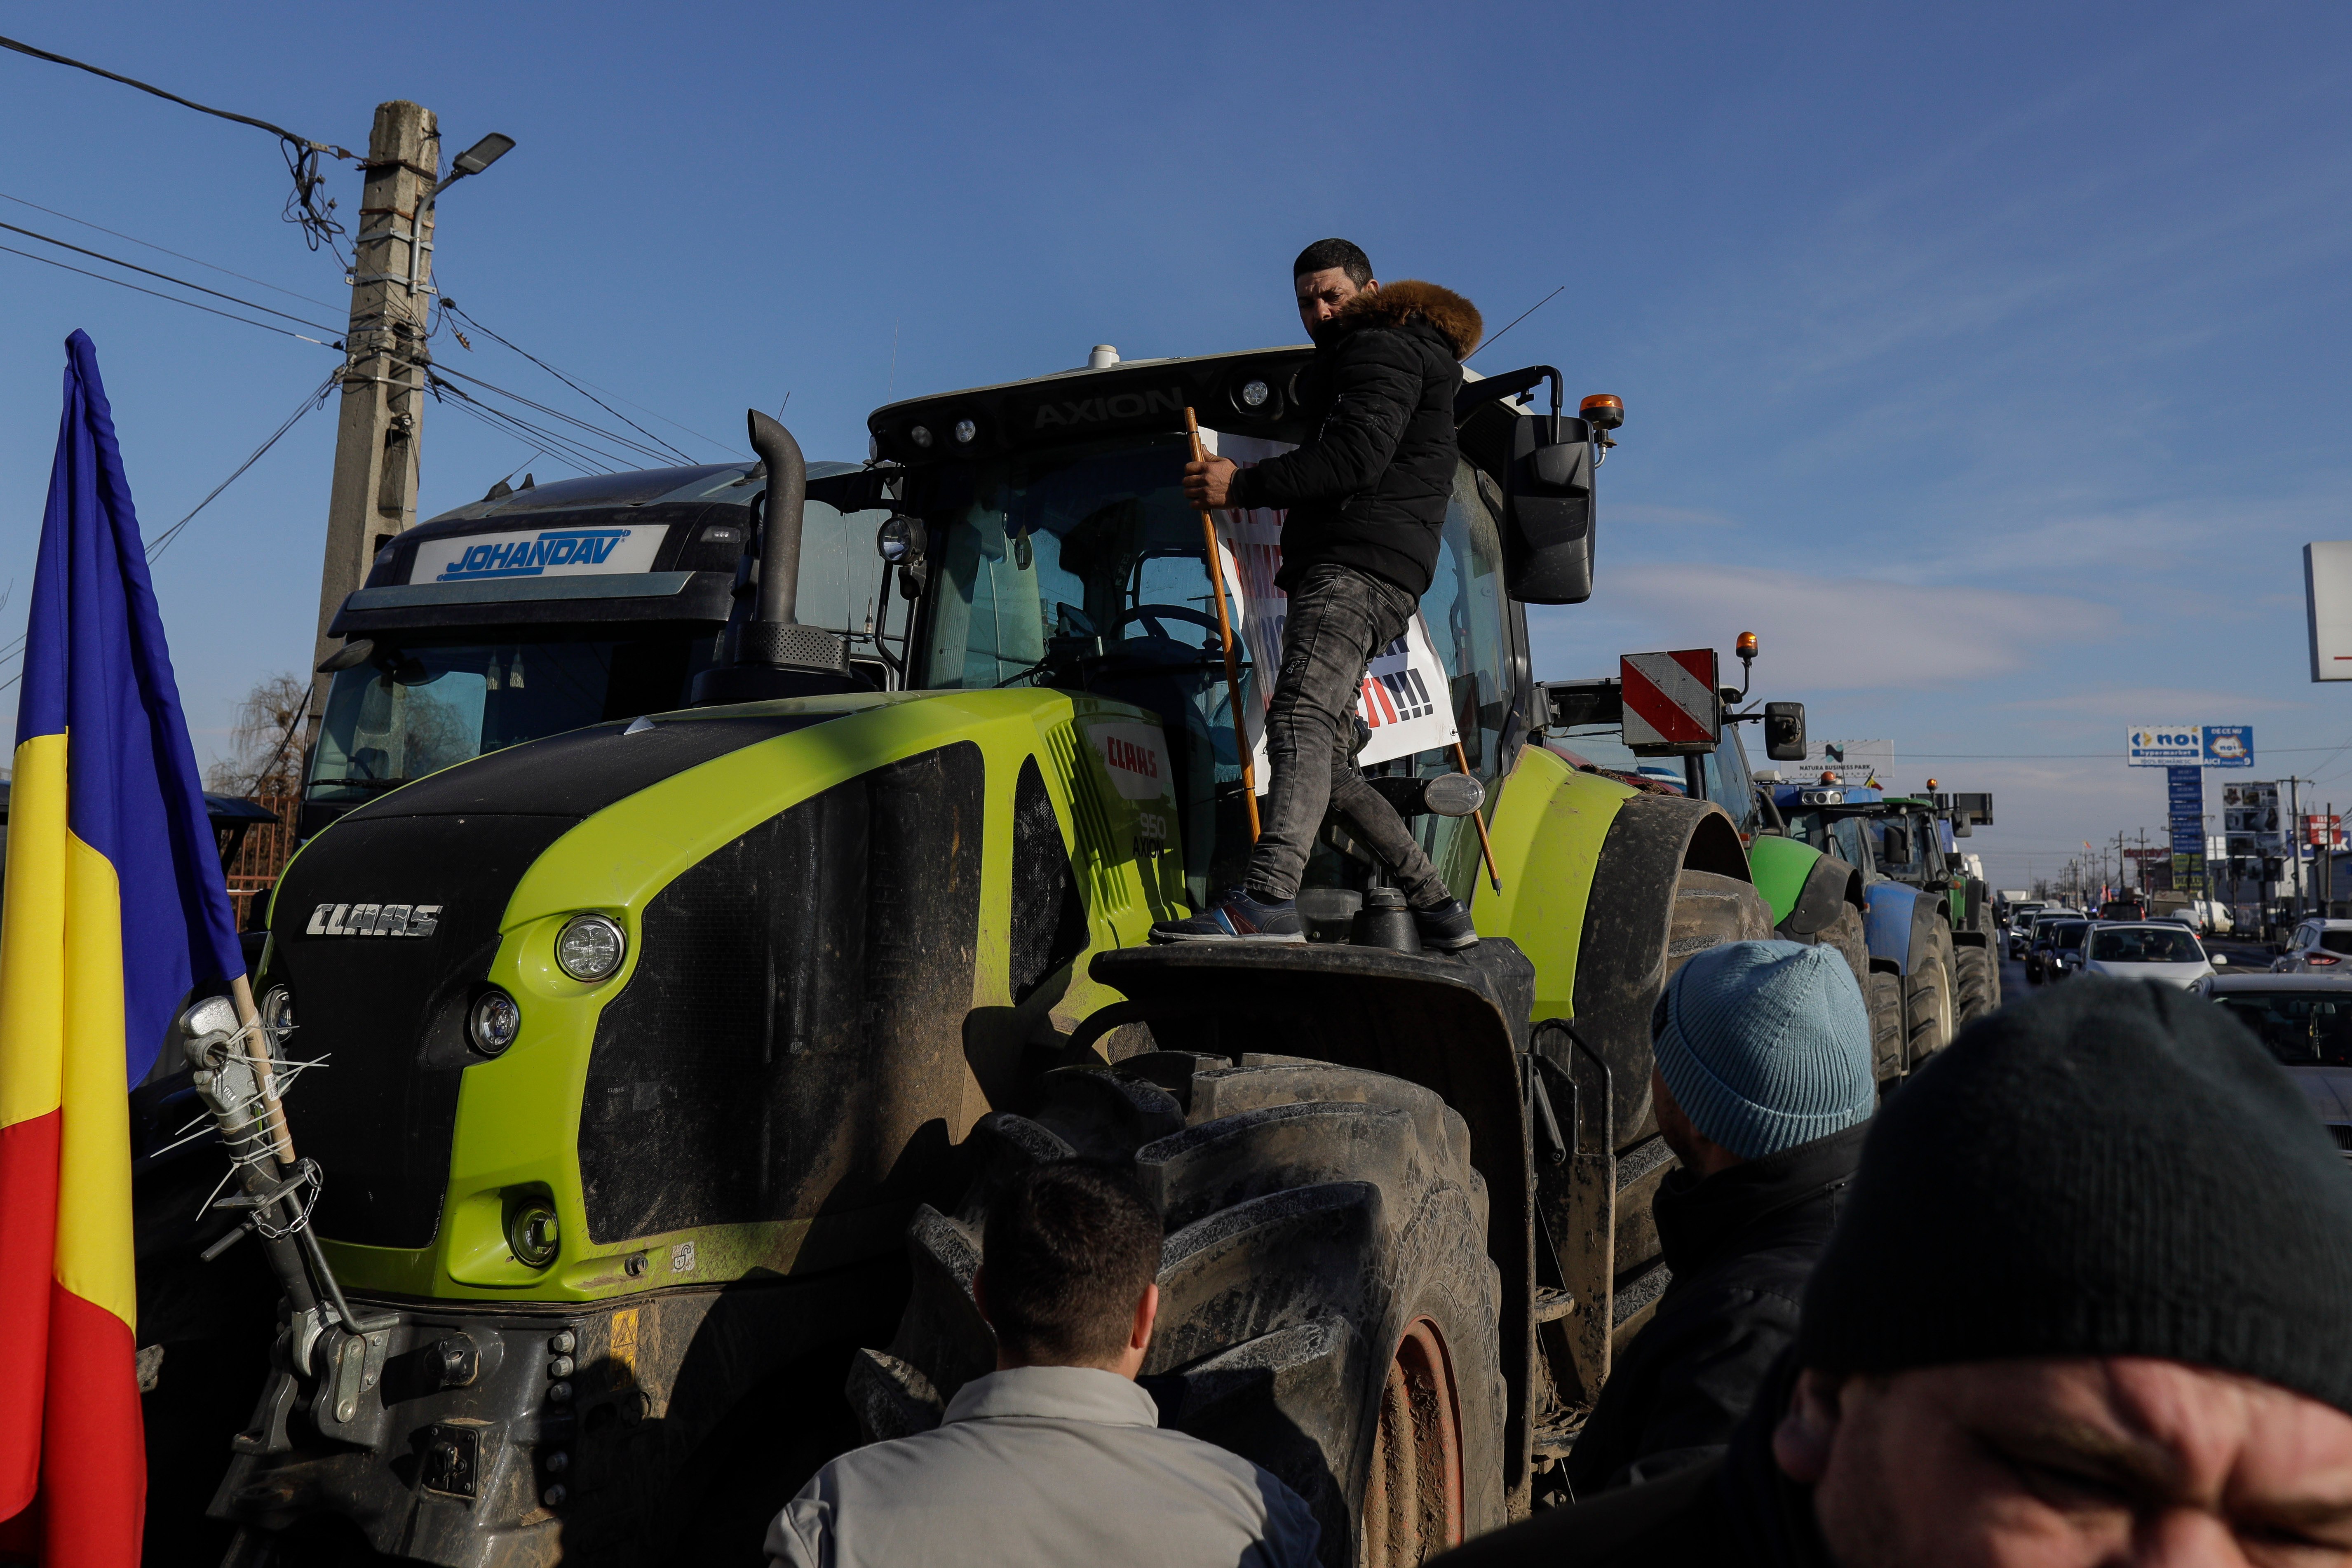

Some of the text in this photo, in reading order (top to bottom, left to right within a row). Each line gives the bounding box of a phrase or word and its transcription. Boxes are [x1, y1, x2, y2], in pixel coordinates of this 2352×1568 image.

[1034, 387, 1184, 429] AXION
[444, 535, 622, 574] JOHANDAV
[1355, 668, 1433, 728] TI!!!
[2157, 727, 2198, 746] noi
[1107, 736, 1157, 779] CLAAS
[1140, 812, 1167, 840] 950
[1132, 836, 1164, 860] AXION
[306, 904, 443, 937] CLAAS
